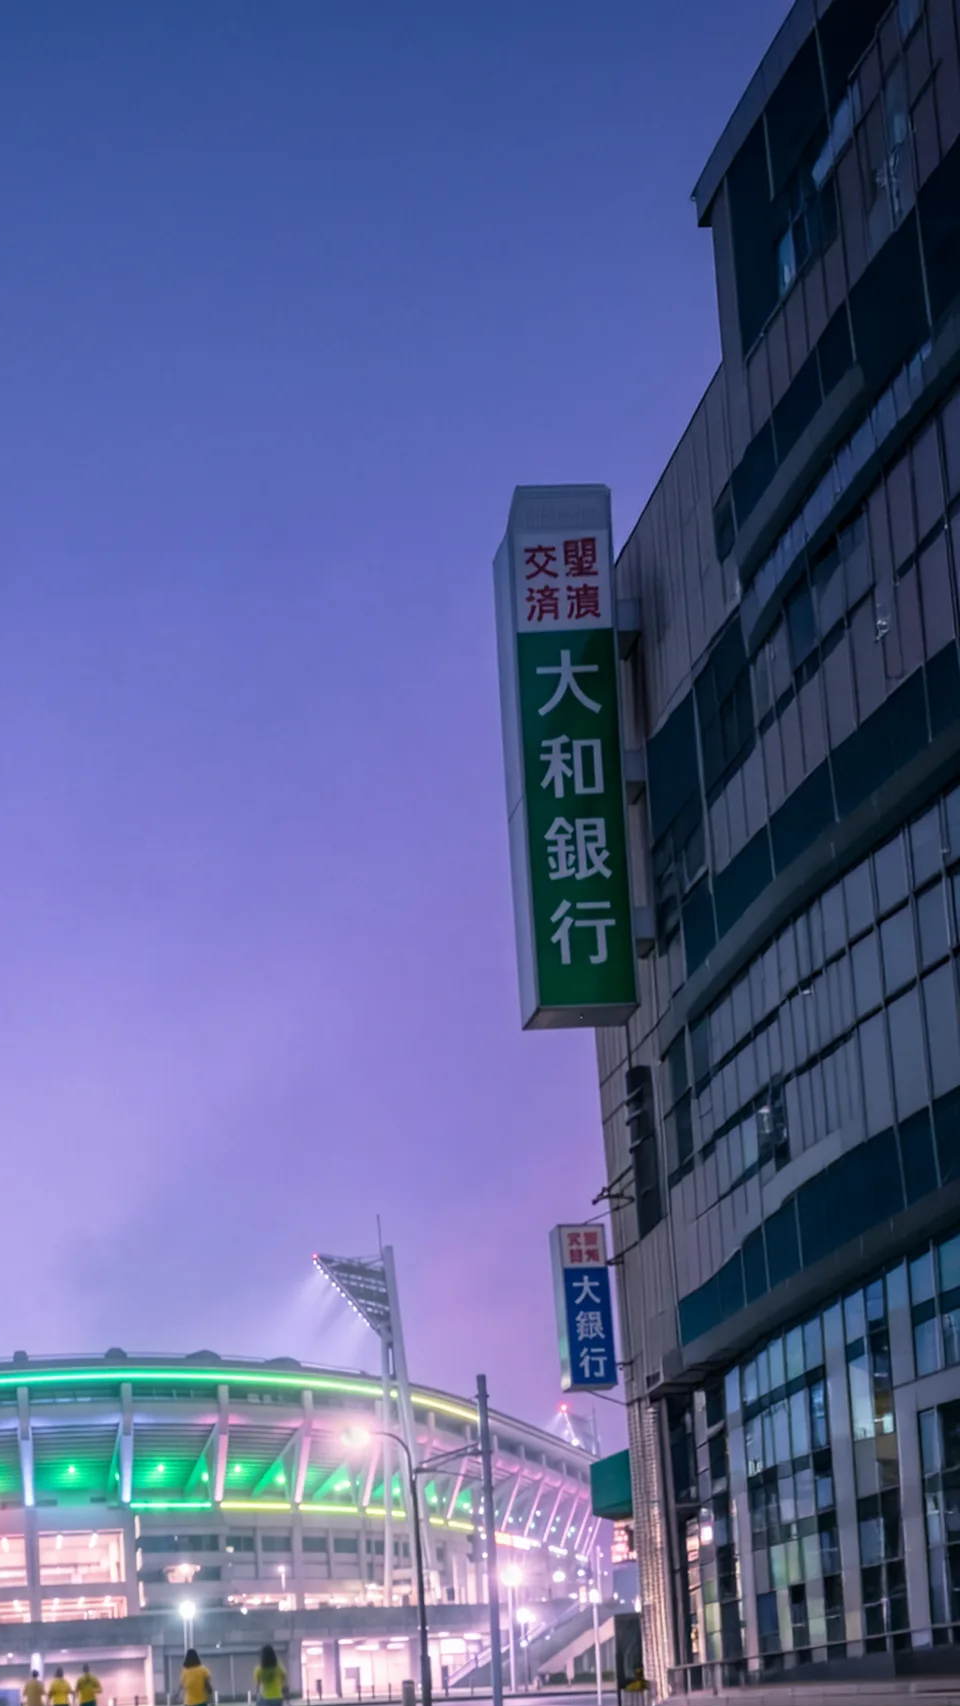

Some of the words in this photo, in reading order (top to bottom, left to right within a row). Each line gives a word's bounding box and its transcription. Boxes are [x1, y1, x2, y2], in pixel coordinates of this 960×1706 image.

[536, 649, 616, 965] 大和銀行
[572, 1275, 608, 1378] 大銀行
